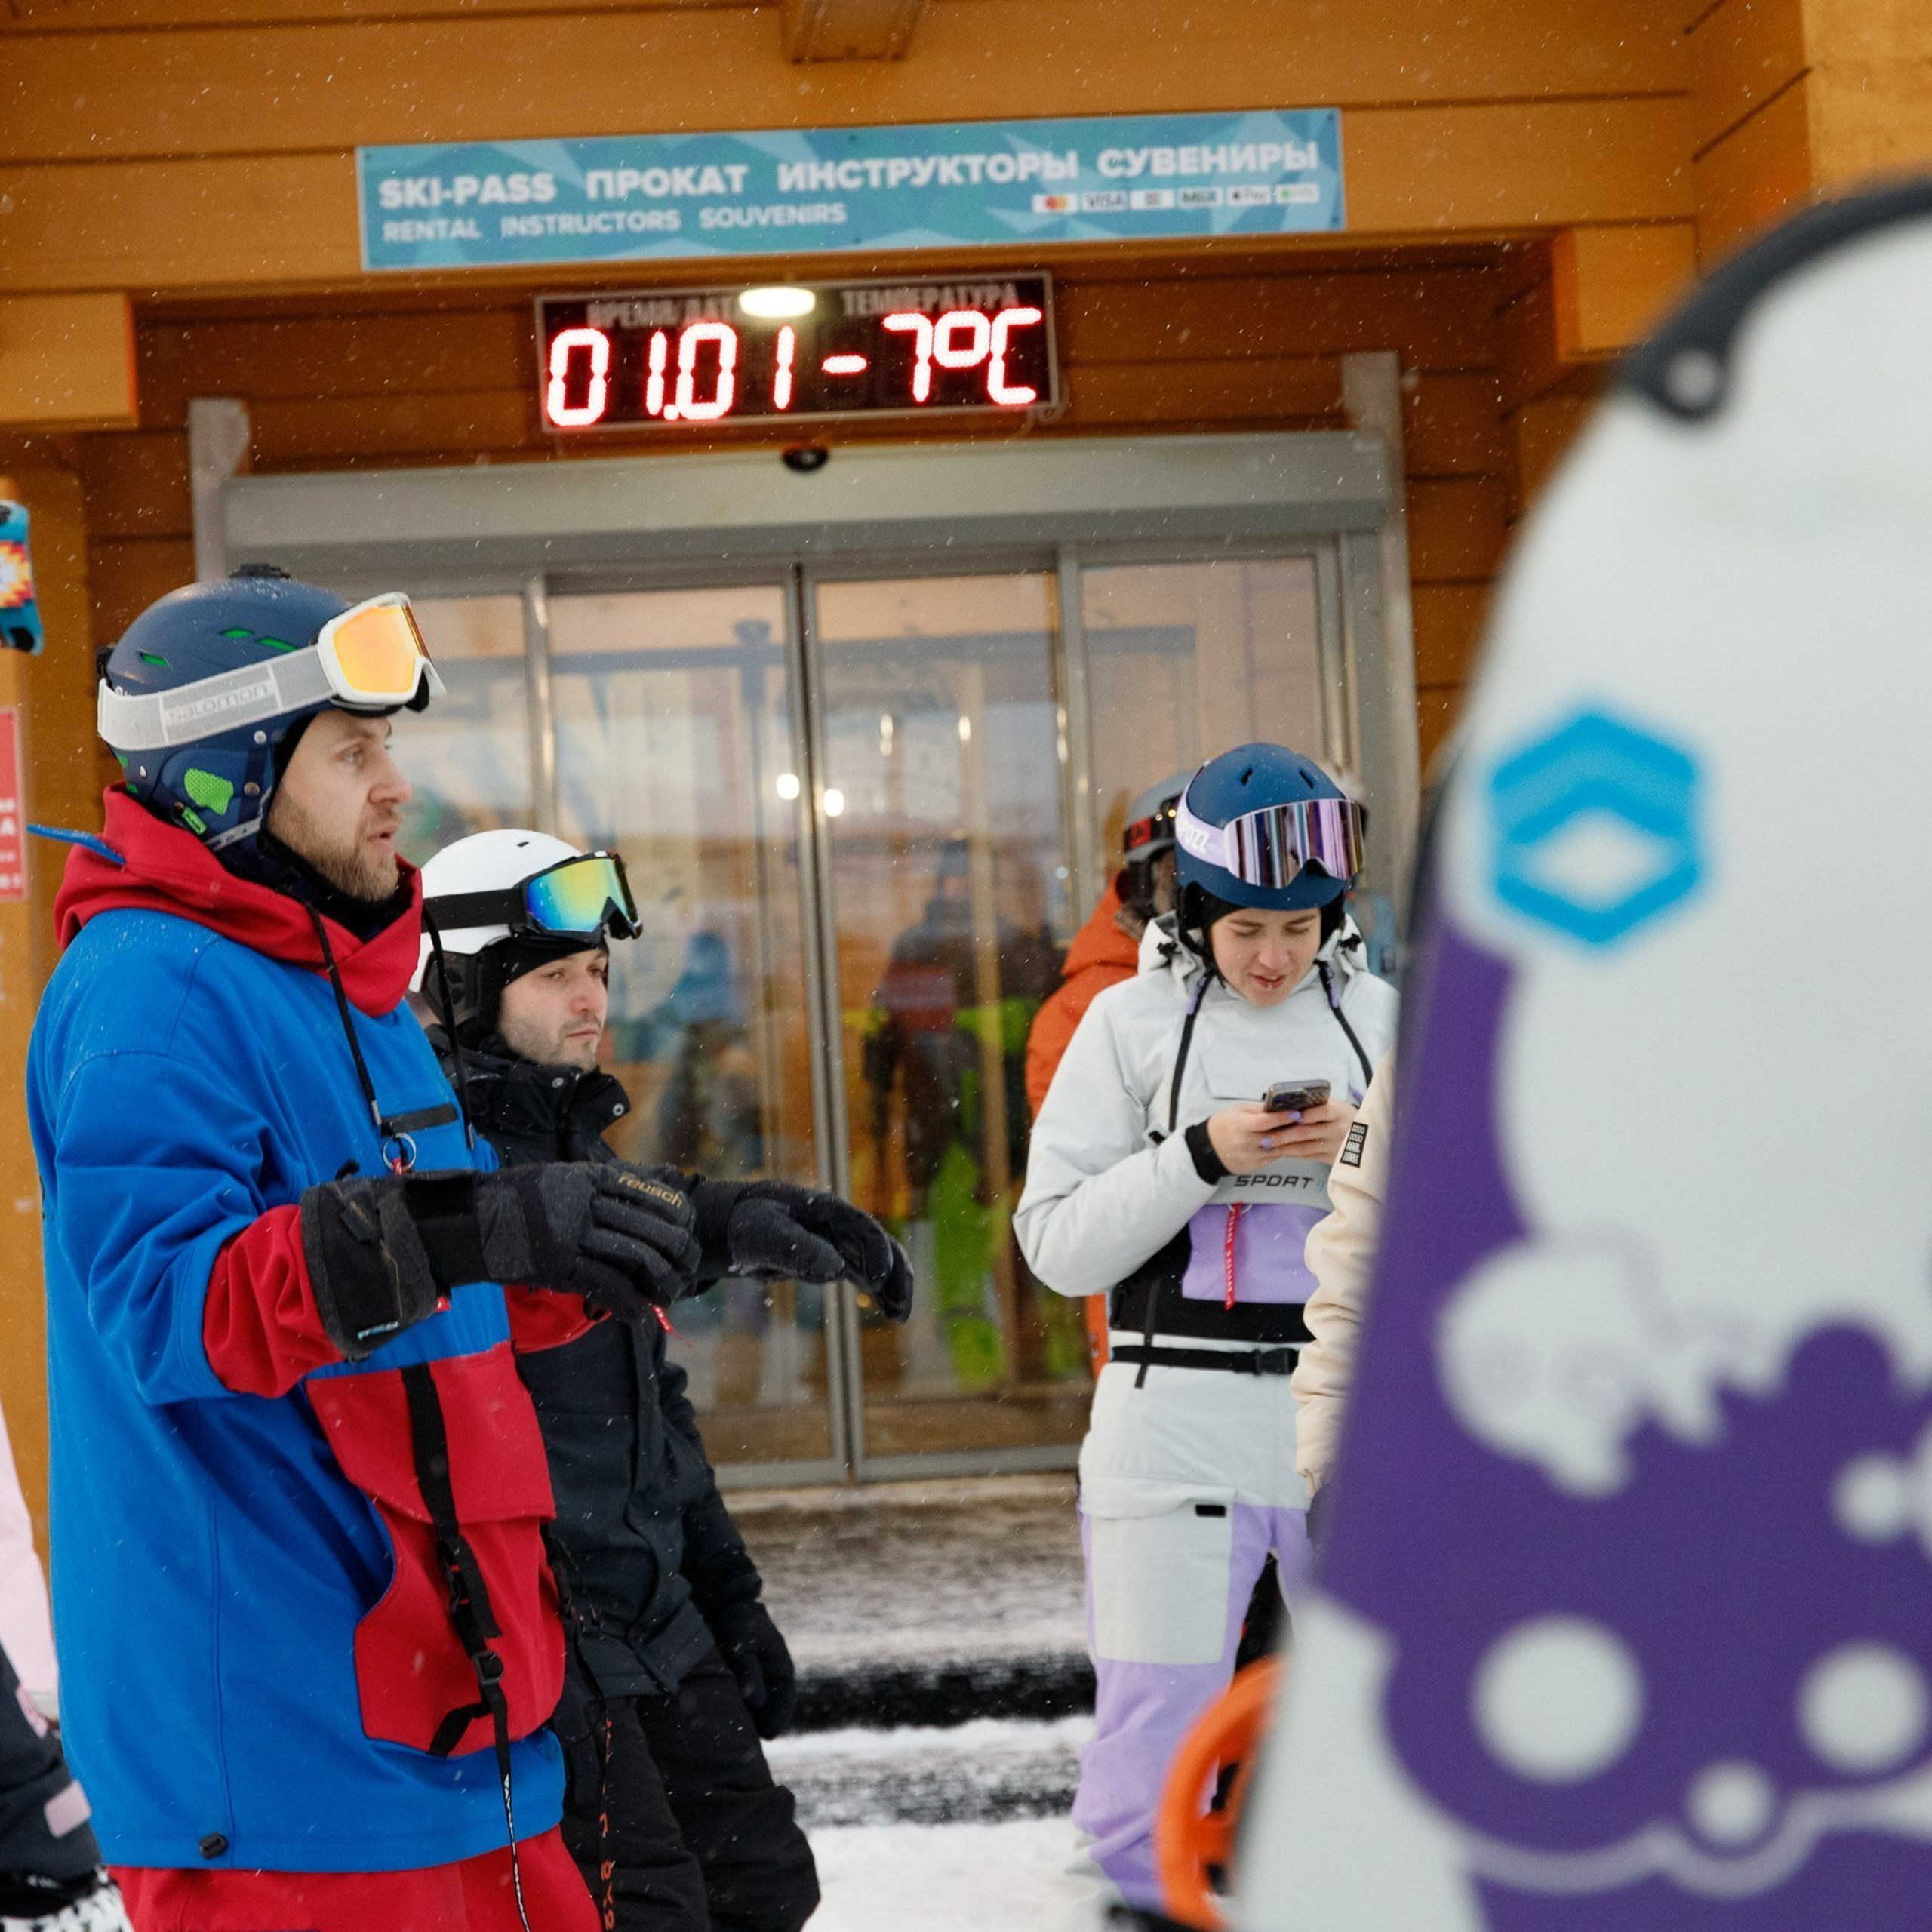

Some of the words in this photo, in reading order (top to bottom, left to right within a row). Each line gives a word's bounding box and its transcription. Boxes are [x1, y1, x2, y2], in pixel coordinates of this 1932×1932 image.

[586, 164, 749, 200] ПРОКАТ
[777, 150, 1078, 192] ИНСТРУКТОРЫ
[1097, 140, 1319, 178] СУВЕНИРЫ
[379, 173, 556, 209] SKI-PASS
[383, 219, 481, 242] RENTAL
[500, 209, 681, 238] INSTRUCTORS
[699, 202, 847, 229] SOUVENIRS
[1234, 1174, 1314, 1189] SPORT
